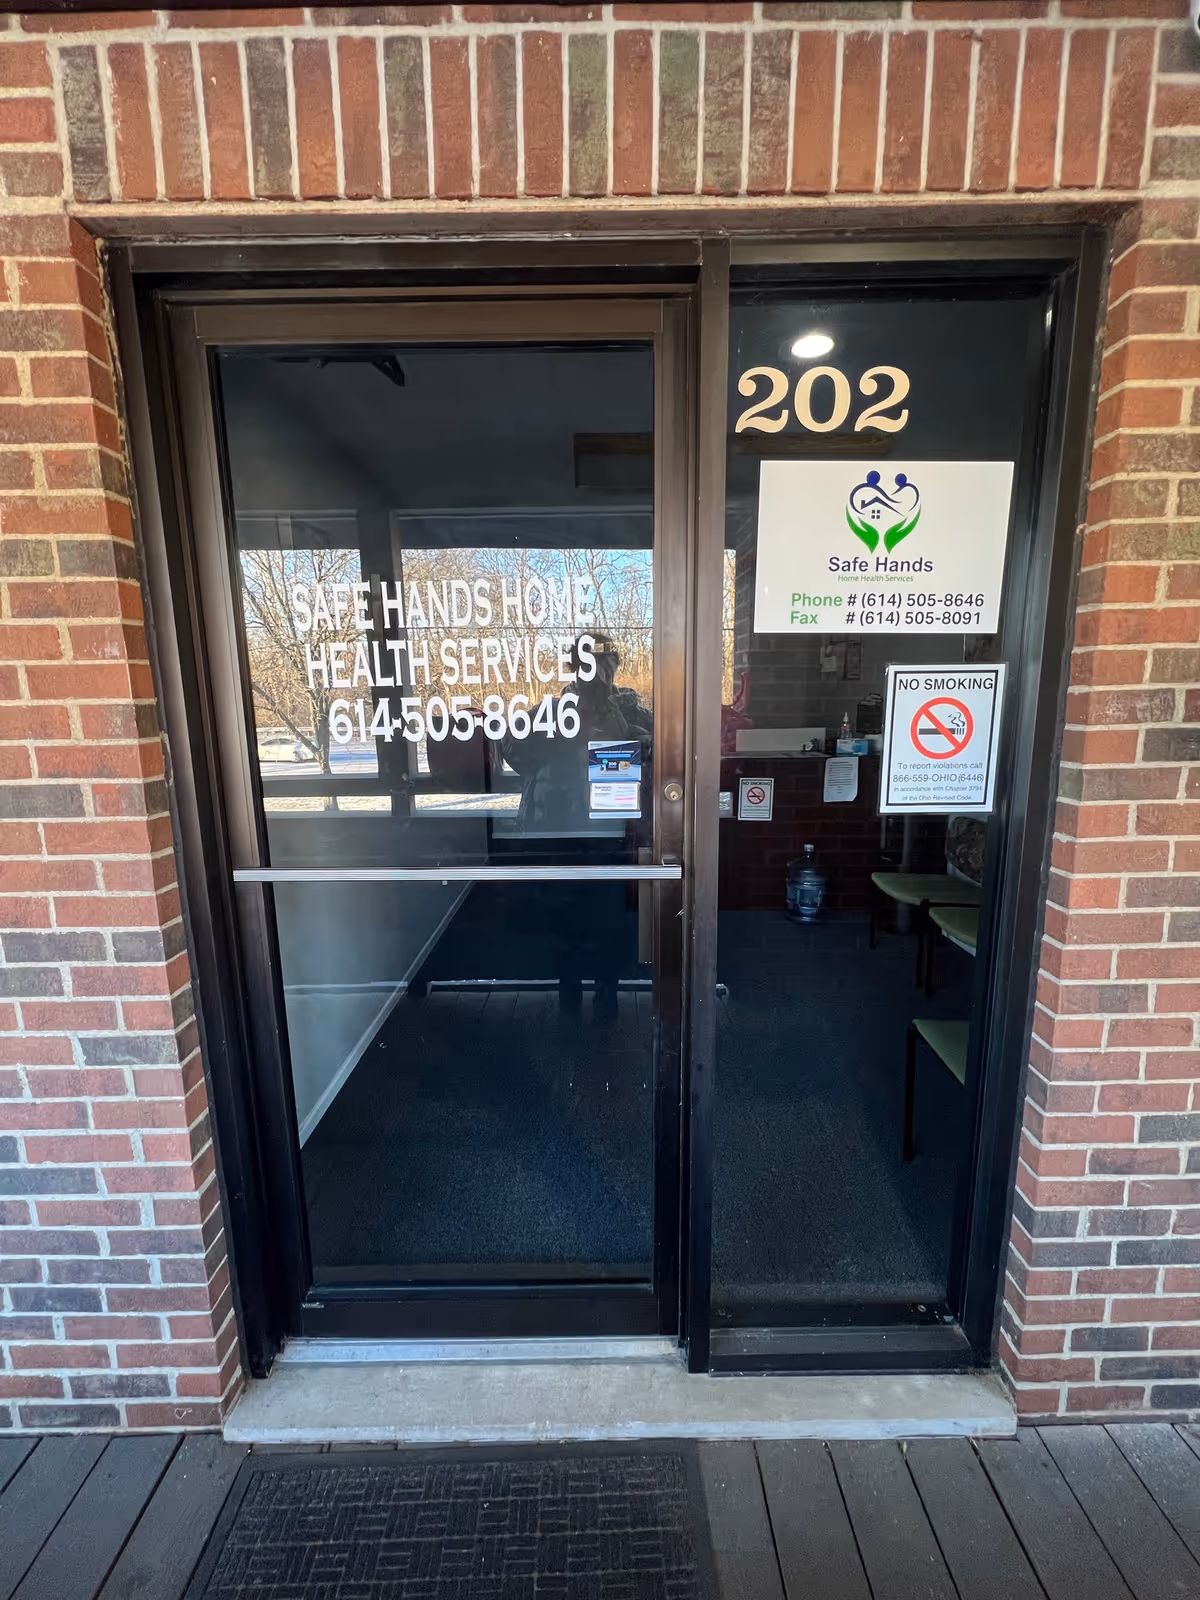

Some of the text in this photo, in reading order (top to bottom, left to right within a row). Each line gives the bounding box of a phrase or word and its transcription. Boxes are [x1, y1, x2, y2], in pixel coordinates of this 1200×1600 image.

[735, 366, 911, 433] 202
[828, 556, 934, 572] Safe Hands
[838, 574, 914, 582] Home Health Services
[292, 575, 595, 632] SAFE HANDS HOME
[791, 592, 985, 609] Phone # (614) 505-8646
[790, 611, 982, 627] Fax # (614) 505-8091
[305, 634, 597, 689] HEALTH SERVICES
[898, 677, 994, 691] NO SMOKING
[329, 692, 580, 744] 614-505-8646
